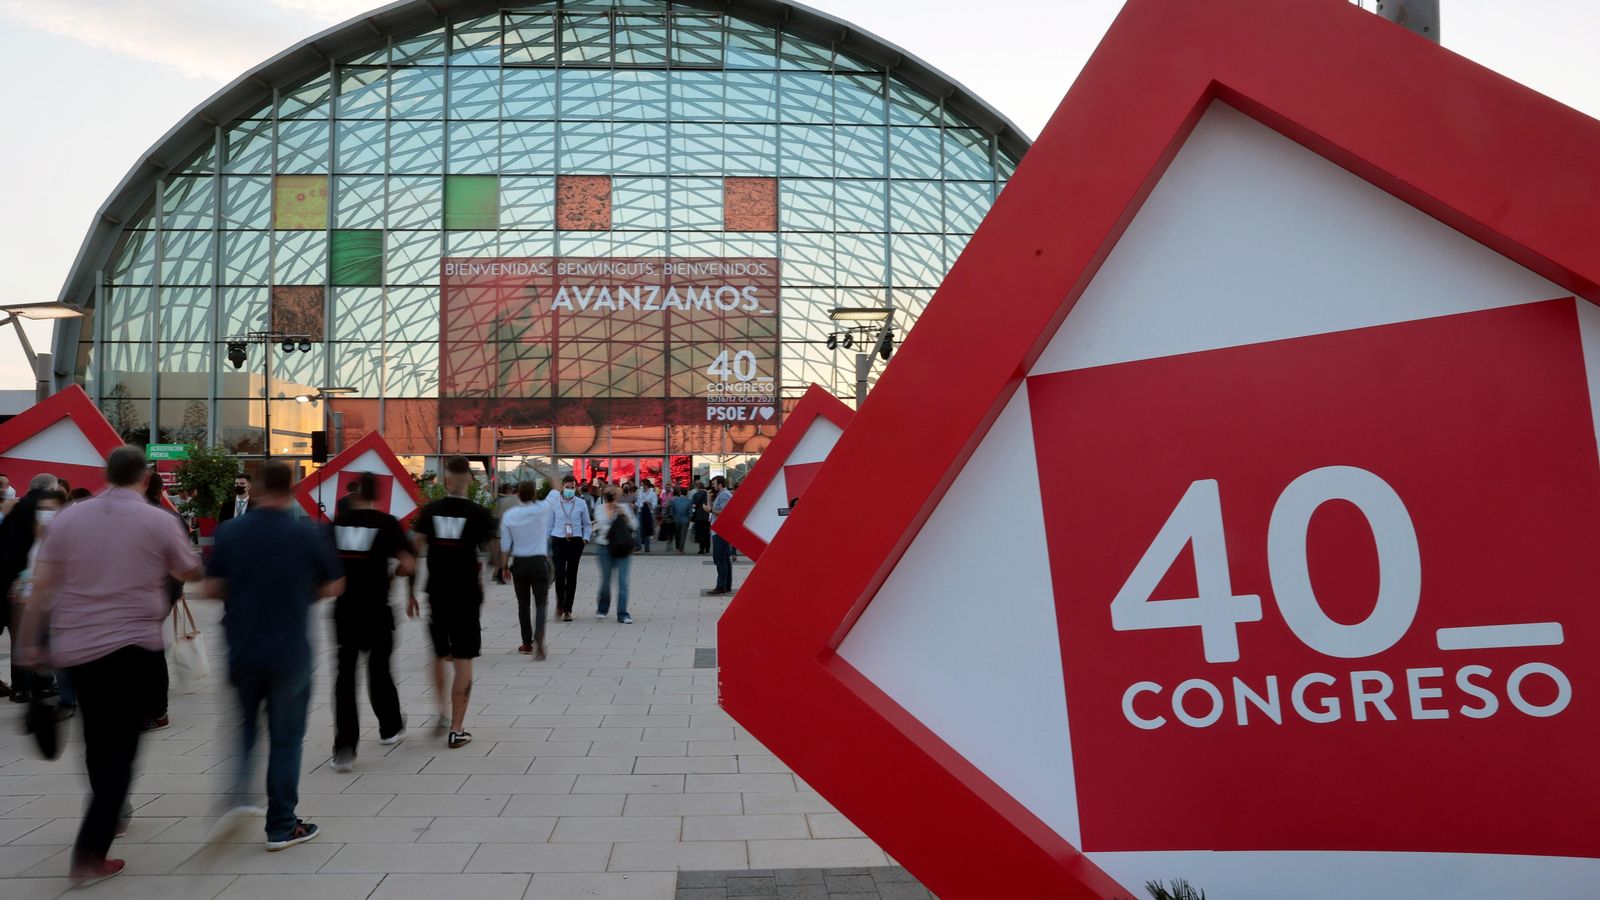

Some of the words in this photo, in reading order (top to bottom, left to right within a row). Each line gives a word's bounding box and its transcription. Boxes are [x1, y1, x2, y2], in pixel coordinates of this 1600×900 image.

[706, 383, 774, 392] CONGRESO
[706, 406, 747, 421] PSOE
[1121, 662, 1573, 730] CONGRESO
